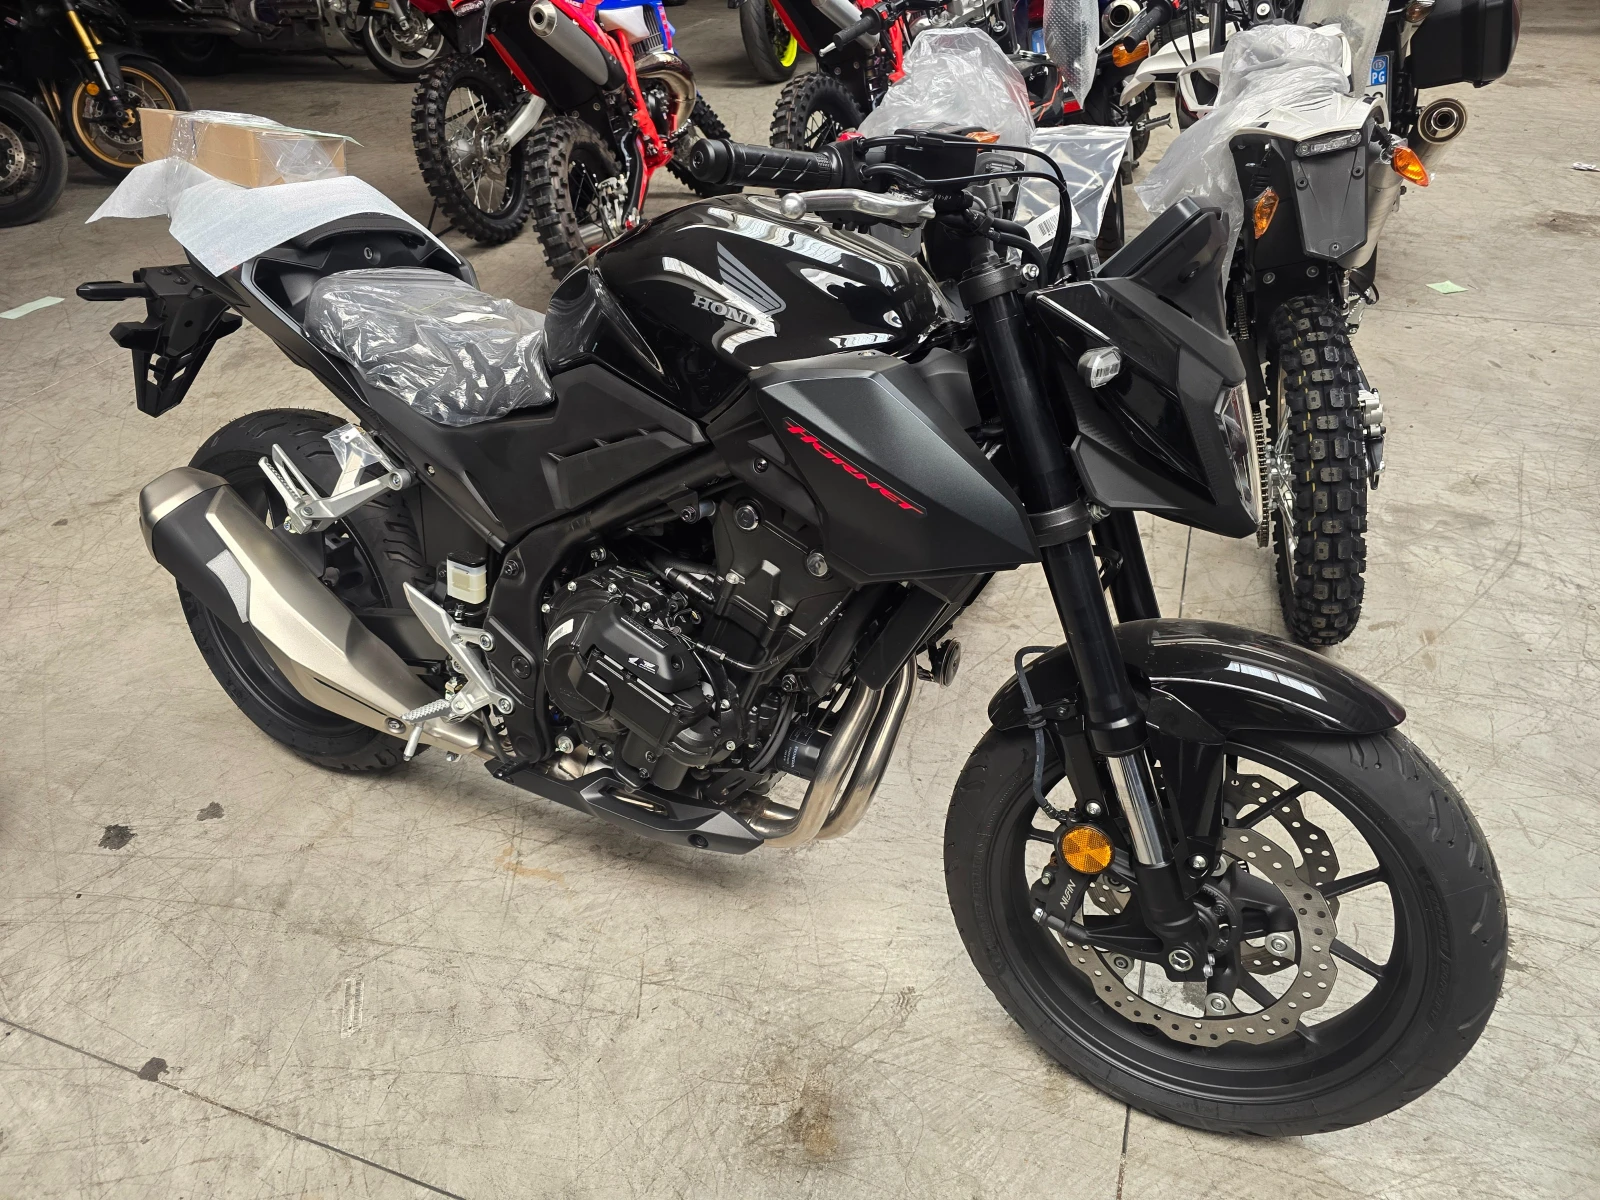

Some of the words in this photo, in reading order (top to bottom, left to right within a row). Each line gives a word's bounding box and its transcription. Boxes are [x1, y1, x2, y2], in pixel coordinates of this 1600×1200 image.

[1372, 71, 1385, 84] PG
[691, 292, 779, 333] HOND
[1059, 878, 1076, 910] NISSIN
[1427, 888, 1449, 951] MICHELIN
